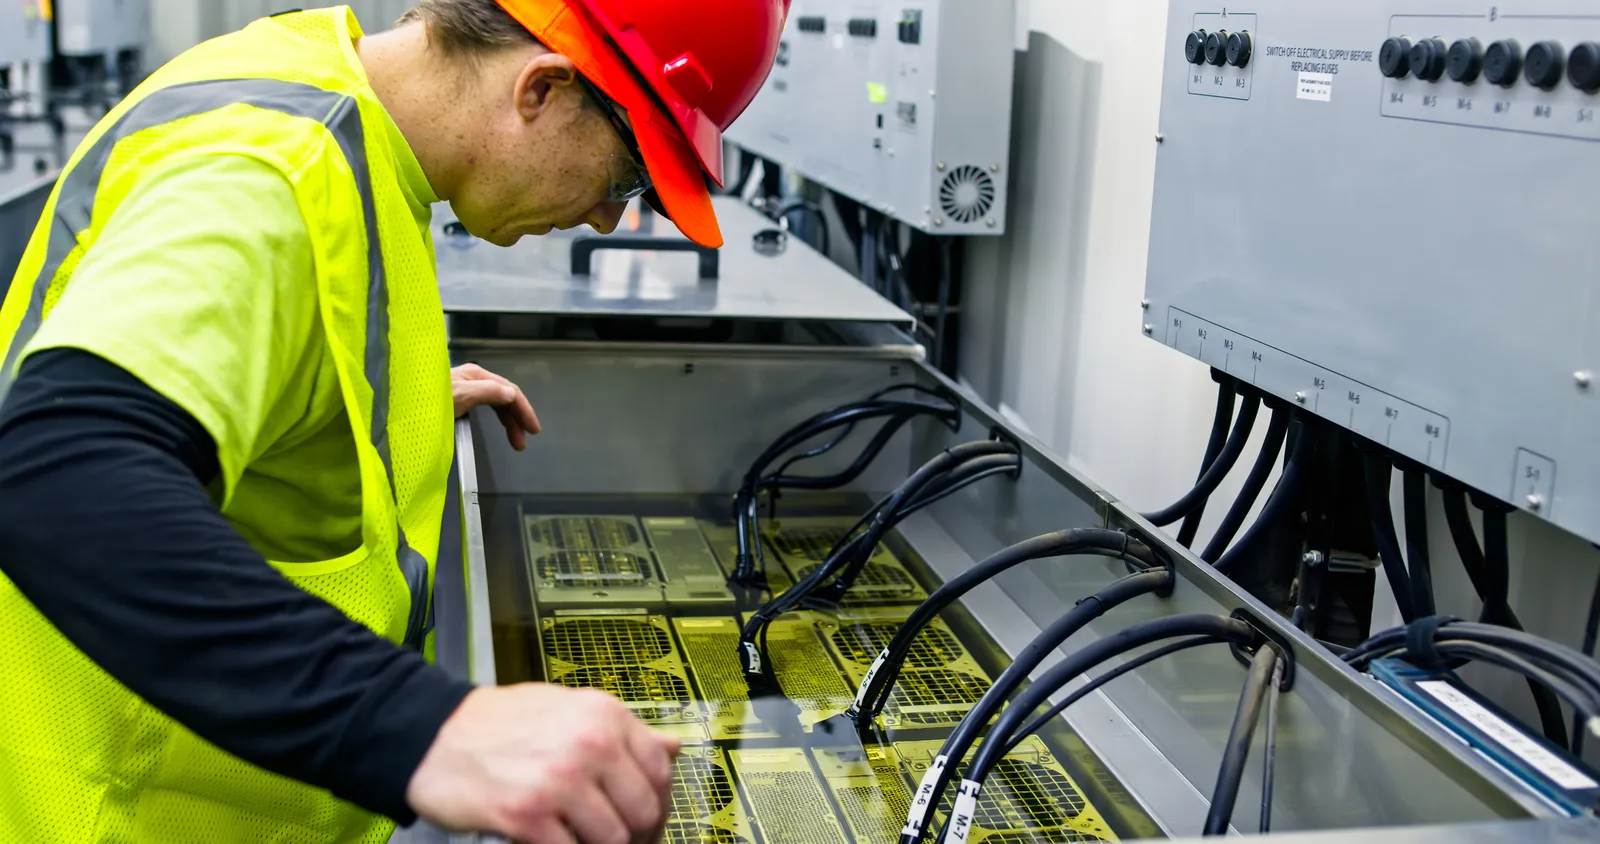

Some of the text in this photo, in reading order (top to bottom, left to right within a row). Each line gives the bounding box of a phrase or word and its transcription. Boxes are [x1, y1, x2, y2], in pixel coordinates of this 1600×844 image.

[1221, 7, 1227, 18] A
[1490, 6, 1498, 21] B
[1266, 46, 1373, 62] SWITCH OFF ELECTRICAL SUPPLY BEFORE
[1291, 61, 1339, 75] REPLACING FUSES
[1193, 75, 1202, 84] M-1
[1214, 76, 1224, 86] M-2
[1236, 78, 1246, 89] M-3
[1390, 92, 1404, 104] M-4
[1422, 95, 1438, 108] M-5
[1457, 98, 1473, 111] M-6
[1494, 102, 1511, 114] M-7
[1534, 105, 1552, 118] M-8
[1174, 318, 1182, 329] M-1
[1198, 328, 1207, 340] M-2
[1224, 339, 1234, 351] M-3
[1252, 350, 1262, 363] M-4
[1313, 377, 1325, 390] M-5
[1348, 391, 1360, 405] M-6
[1384, 406, 1399, 420] M-7
[1424, 424, 1440, 438] M-8
[1525, 465, 1541, 482] S-1
[862, 669, 873, 688] M-5
[917, 783, 932, 805] M-6
[953, 814, 969, 840] M-7
